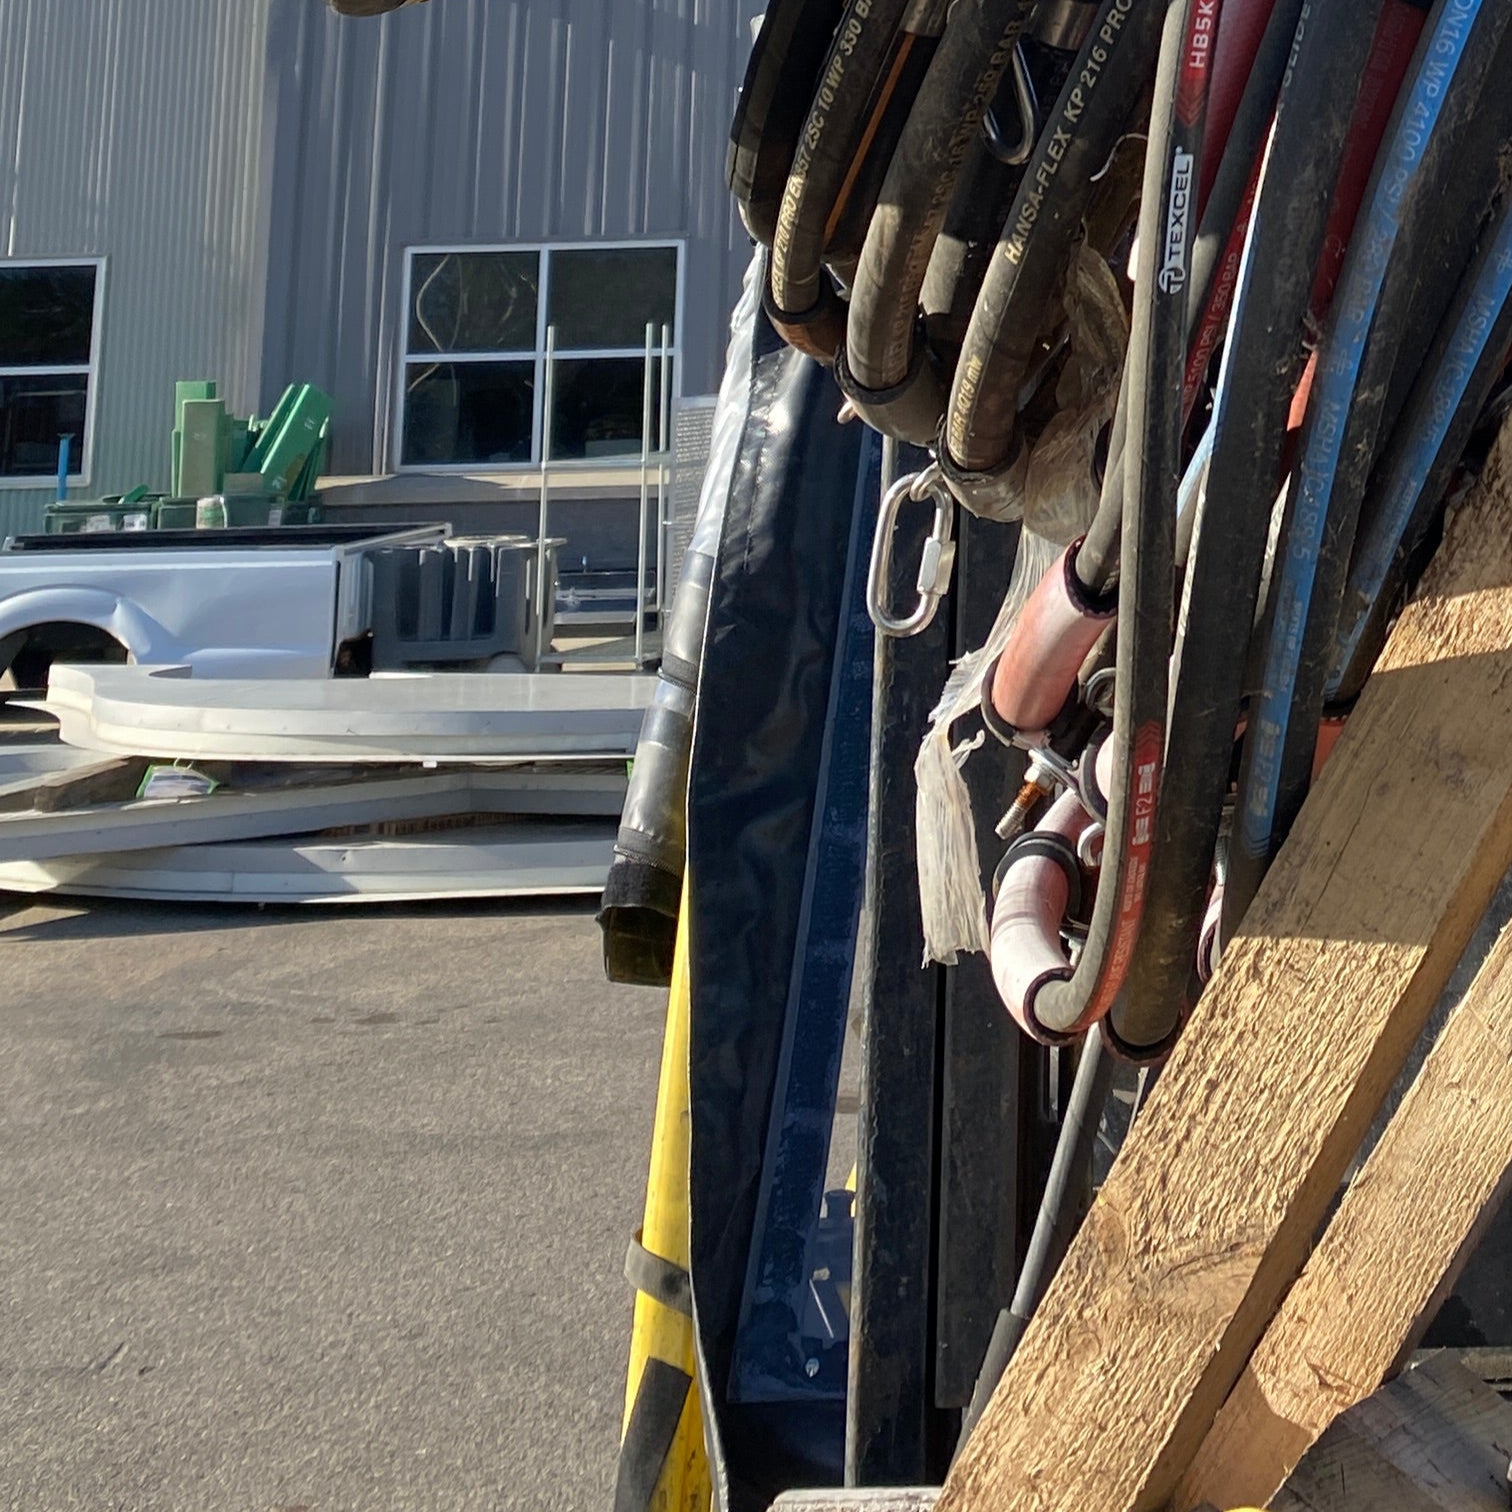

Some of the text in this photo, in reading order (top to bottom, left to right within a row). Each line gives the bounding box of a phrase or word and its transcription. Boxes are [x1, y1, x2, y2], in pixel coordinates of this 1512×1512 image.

[838, 17, 864, 57] 330
[824, 55, 845, 91] WP
[1425, 60, 1450, 99] WP
[817, 88, 836, 111] 10
[801, 112, 825, 150] 2SC
[1004, 123, 1073, 266] HANSA-FLEX
[1063, 87, 1086, 123] KP
[1080, 44, 1109, 91] 216
[1167, 155, 1194, 261] TEXCEL
[956, 354, 984, 413] 4Q19 mw
[1135, 795, 1154, 818] F2
